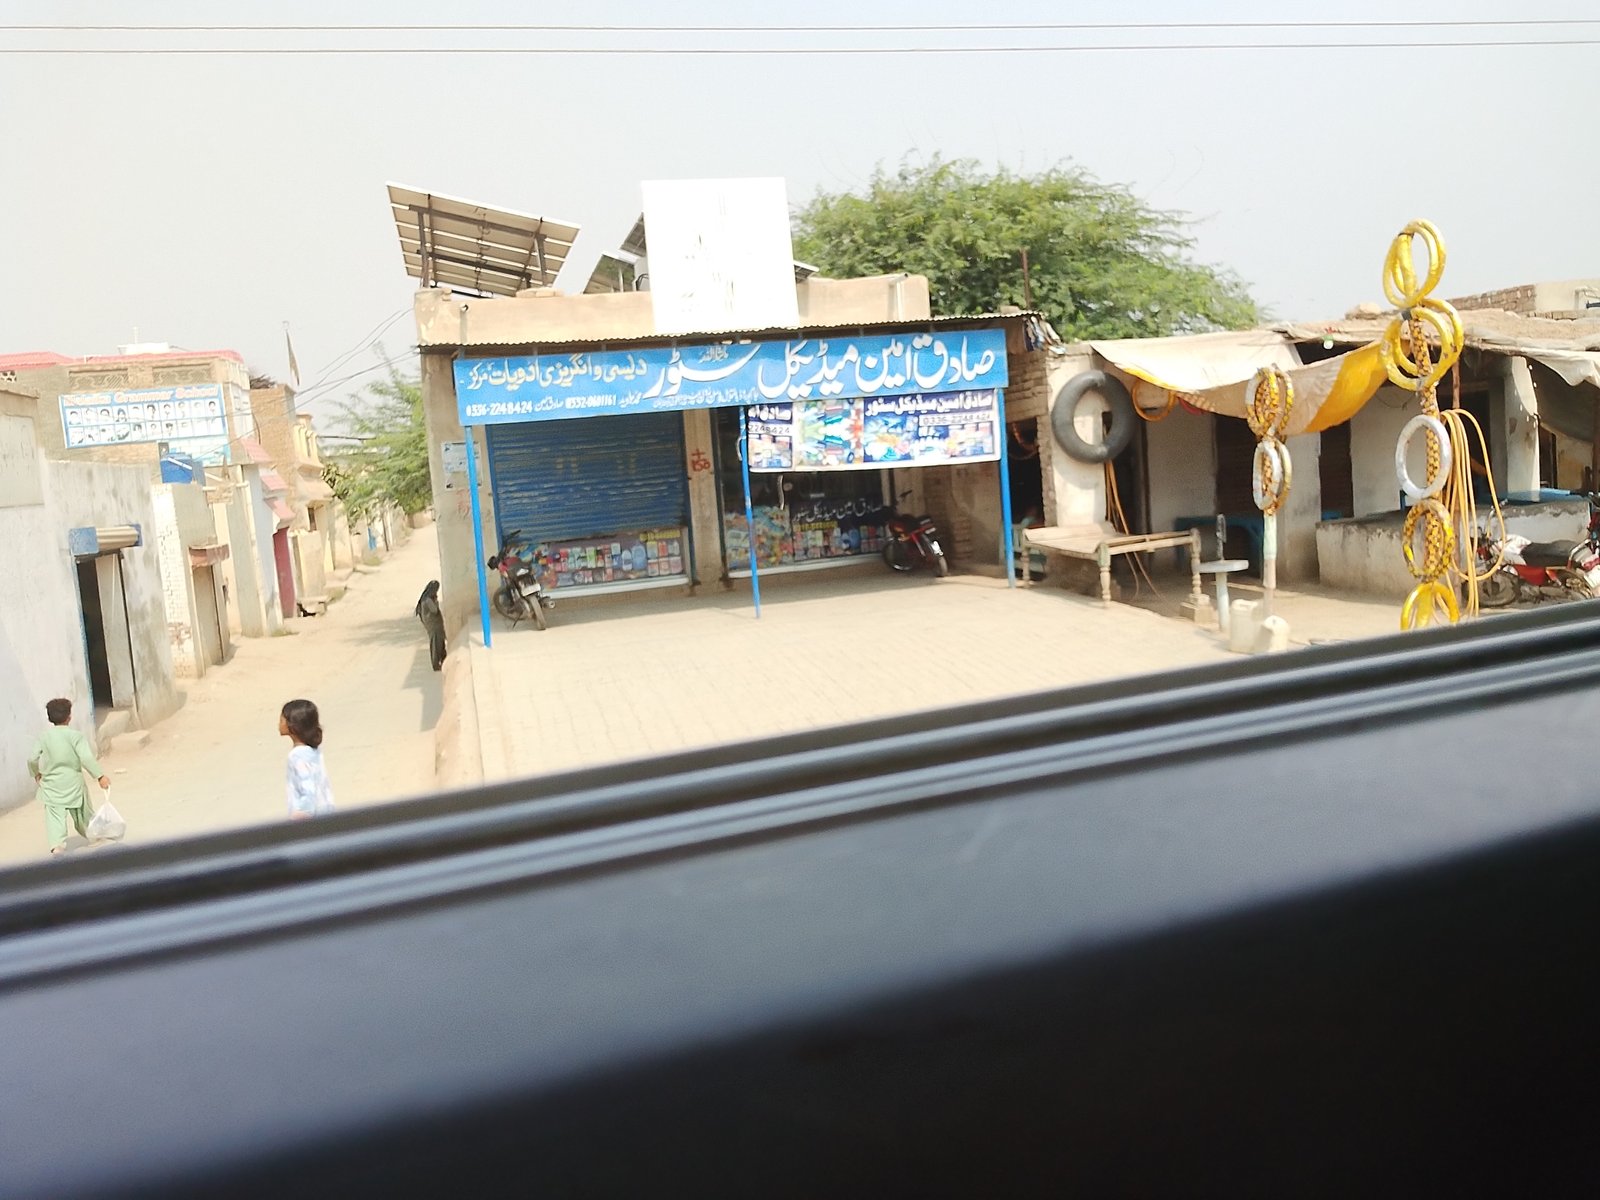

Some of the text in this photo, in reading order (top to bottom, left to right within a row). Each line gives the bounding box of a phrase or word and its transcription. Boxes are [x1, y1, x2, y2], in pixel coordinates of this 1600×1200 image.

[540, 352, 593, 388] انگریزی
[643, 333, 995, 400] صادق امین میڈیکل سٹور
